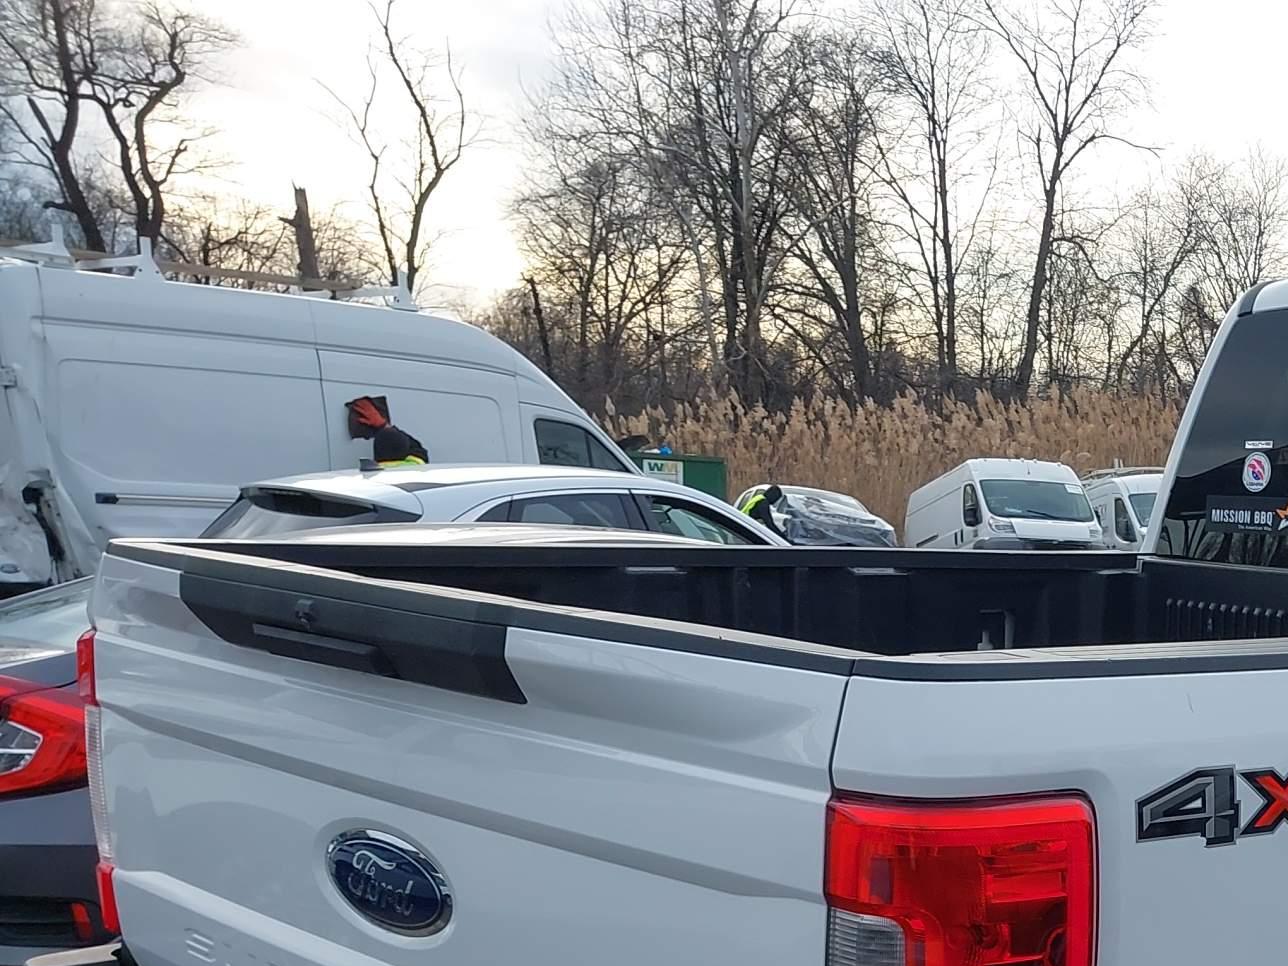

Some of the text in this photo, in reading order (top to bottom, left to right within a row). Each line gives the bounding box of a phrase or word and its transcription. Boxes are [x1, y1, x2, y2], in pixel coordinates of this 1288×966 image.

[1211, 509, 1273, 527] MISSION BBQ
[347, 850, 415, 916] Ford
